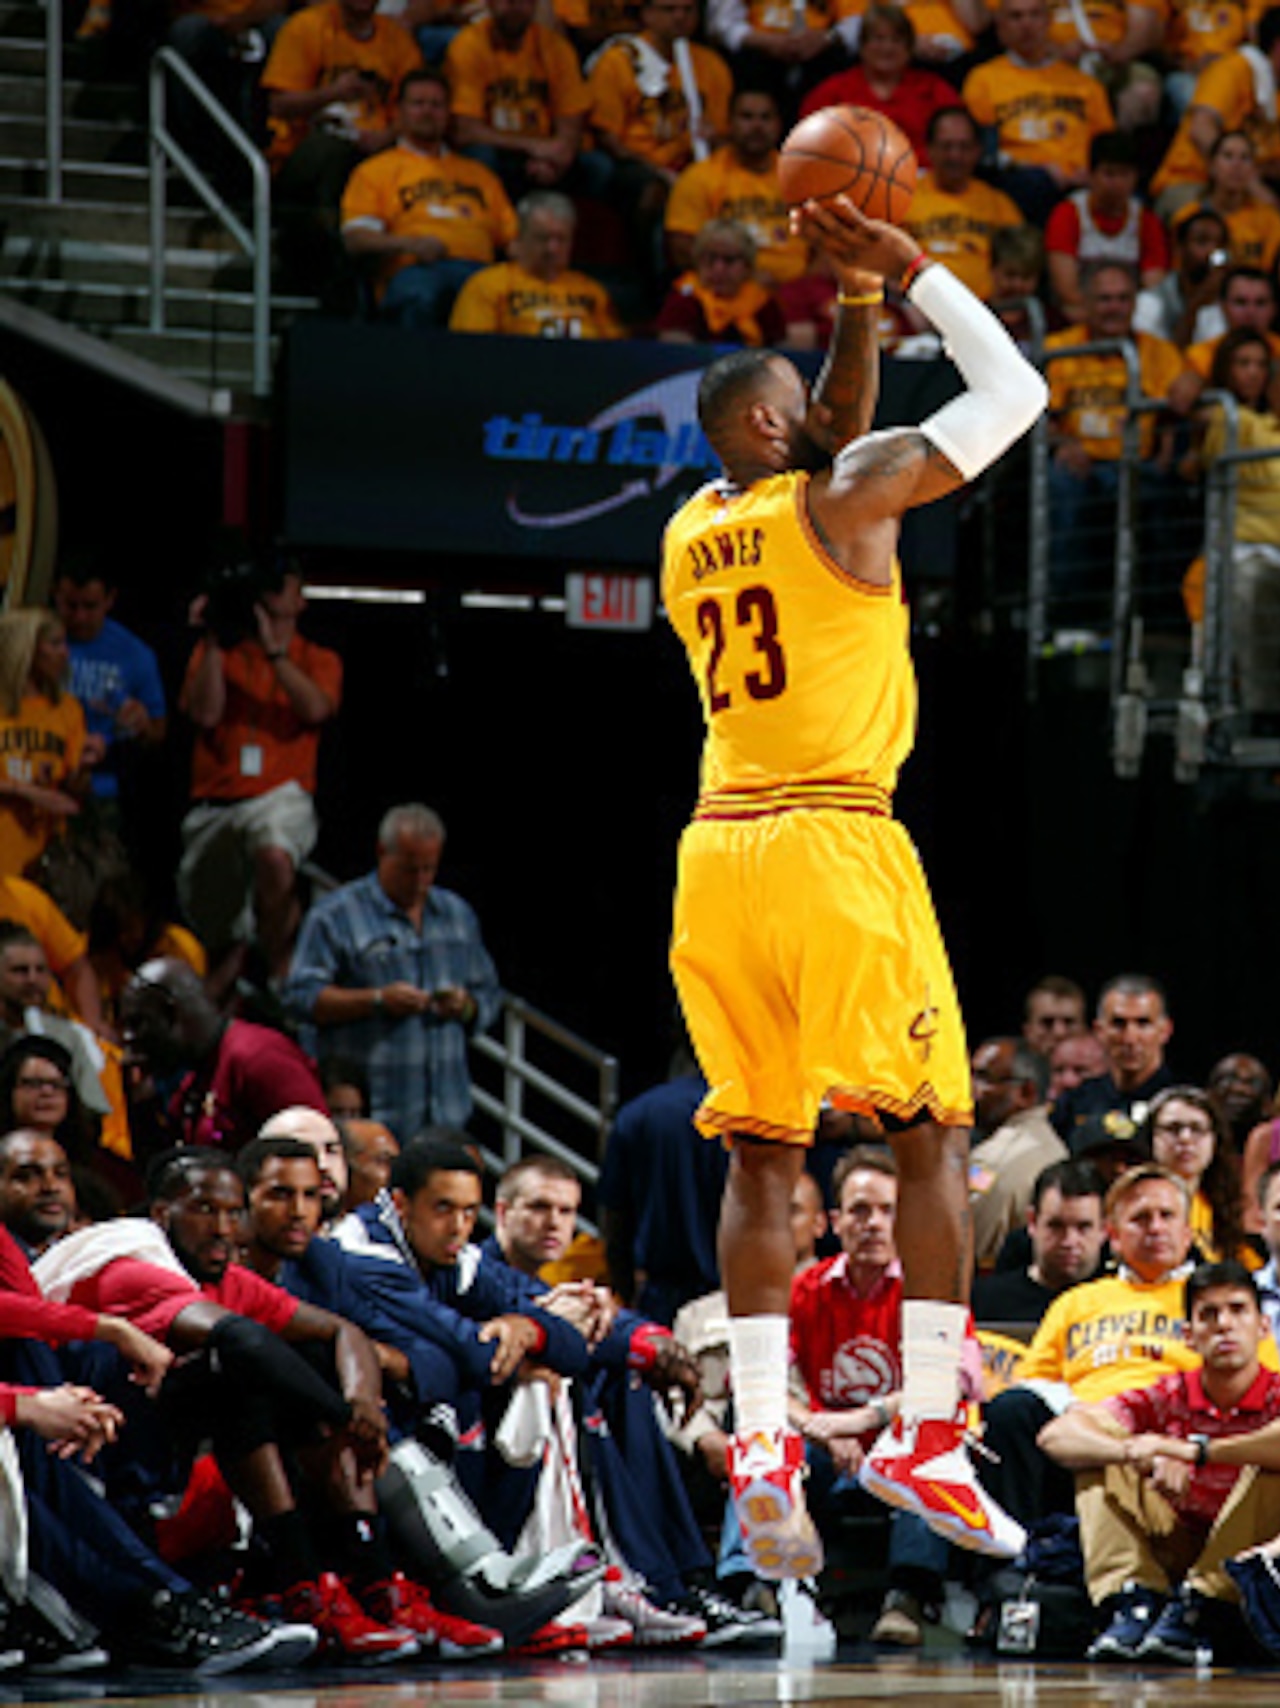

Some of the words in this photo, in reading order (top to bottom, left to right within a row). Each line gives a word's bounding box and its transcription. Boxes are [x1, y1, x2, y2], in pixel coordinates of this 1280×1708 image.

[688, 528, 765, 582] JAMES
[582, 571, 641, 622] EXIT
[697, 584, 787, 717] 23
